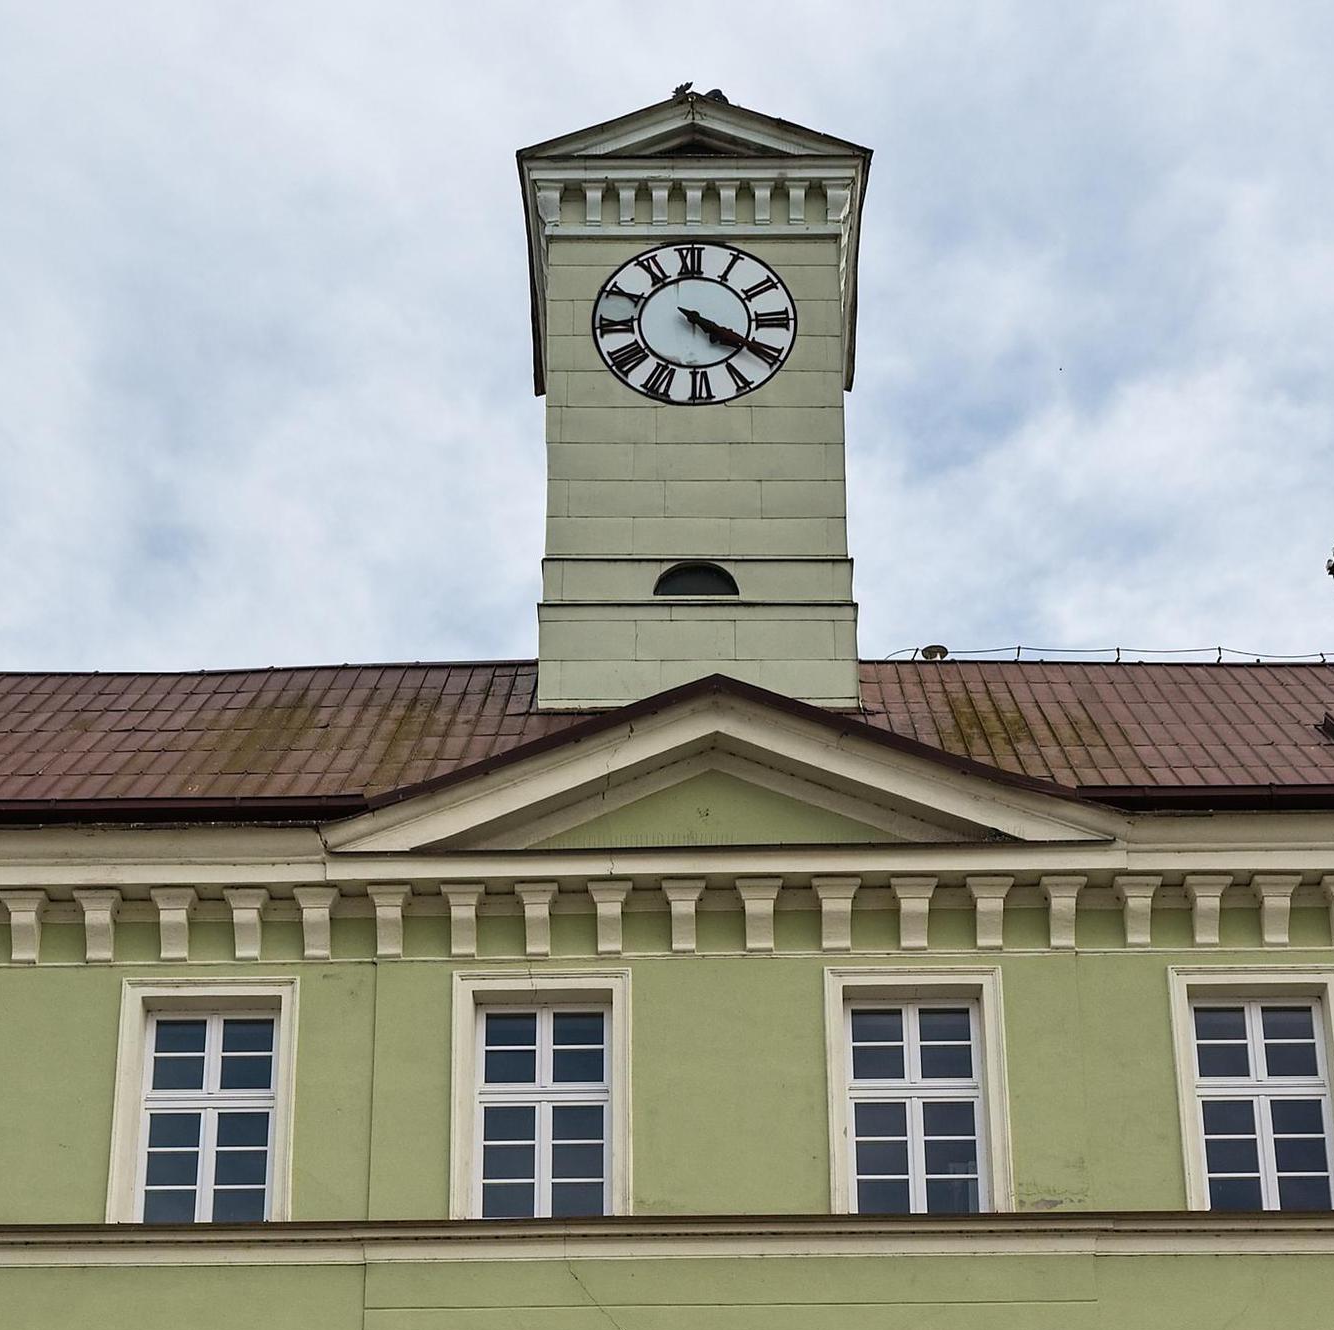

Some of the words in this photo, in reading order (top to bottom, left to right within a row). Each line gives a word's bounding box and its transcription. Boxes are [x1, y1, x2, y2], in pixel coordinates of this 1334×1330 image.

[634, 254, 670, 287] XI
[674, 246, 705, 277] XII
[605, 282, 644, 307] X
[741, 275, 780, 302] II
[600, 314, 635, 338] IX
[754, 307, 790, 331] III
[607, 340, 649, 379] VIII
[640, 362, 676, 398] VII
[688, 370, 716, 400] VI
